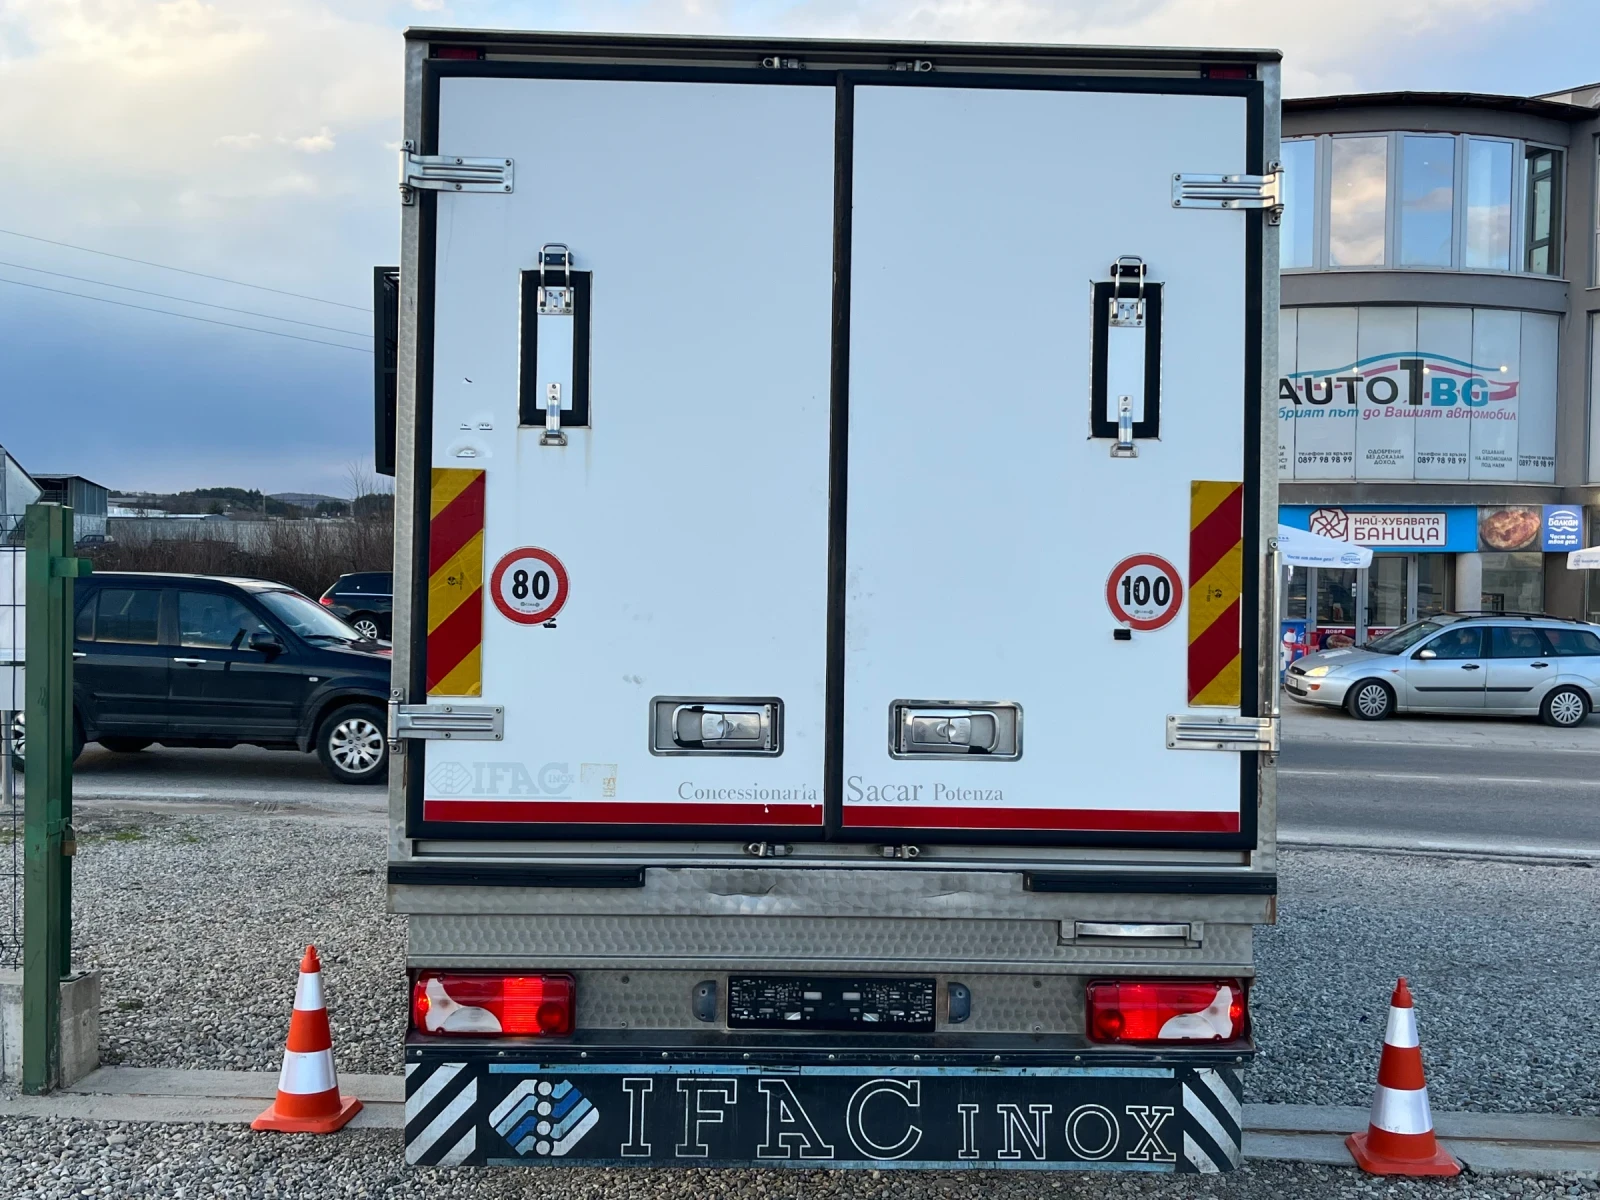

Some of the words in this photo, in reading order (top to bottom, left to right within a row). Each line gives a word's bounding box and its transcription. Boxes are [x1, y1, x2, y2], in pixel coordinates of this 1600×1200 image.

[1328, 409, 1359, 418] път
[1384, 406, 1443, 418] Вашият
[1446, 408, 1516, 421] автомобил
[1319, 456, 1329, 464] 98
[1331, 456, 1341, 464] 98
[1343, 456, 1353, 464] 99
[1417, 456, 1435, 464] 0897
[1354, 515, 1439, 526] НАЙ-ХУБАВАТА
[1548, 518, 1578, 526] Балкан
[1354, 527, 1439, 543] БАНИЦА
[512, 569, 550, 601] 80
[1121, 575, 1171, 607] 100
[471, 761, 570, 796] IFAC
[548, 774, 575, 784] INOX
[677, 781, 818, 800] Concessionaria
[847, 775, 924, 803] Sacar
[932, 782, 1004, 801] Potenza
[620, 1077, 923, 1161] IFAC
[957, 1103, 1177, 1162] INOX
